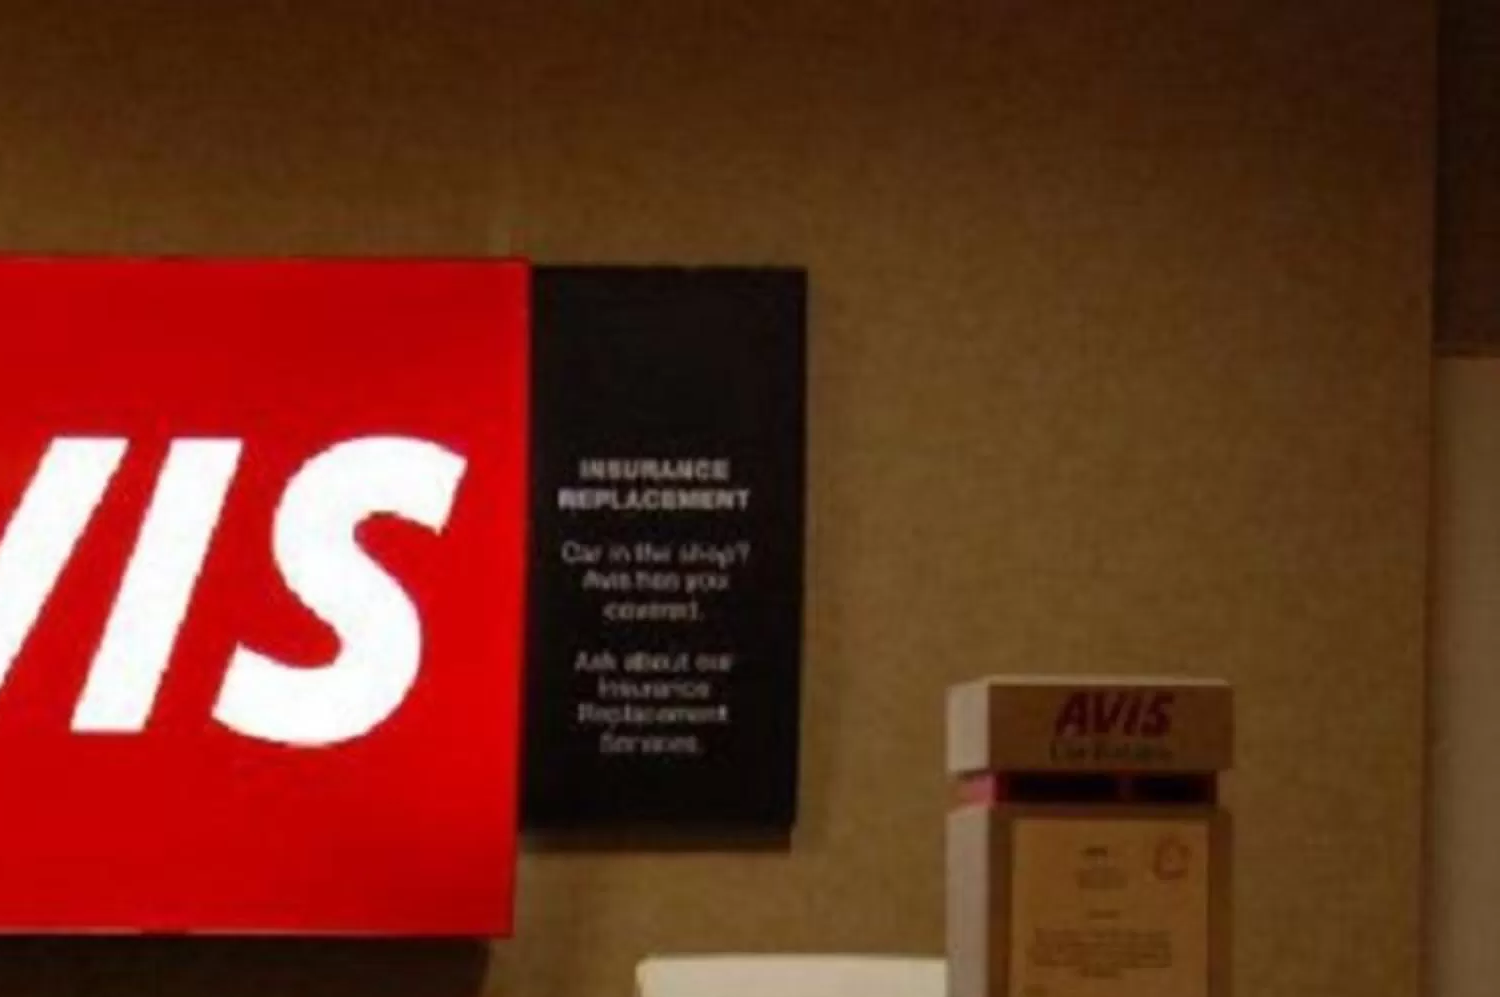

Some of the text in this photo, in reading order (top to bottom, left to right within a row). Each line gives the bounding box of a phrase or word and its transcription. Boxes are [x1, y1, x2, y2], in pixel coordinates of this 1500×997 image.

[579, 458, 730, 480] INSURANCE
[557, 488, 750, 510] REPLACEMENT
[561, 541, 750, 568] Car in the shop?
[581, 570, 631, 590] Avis
[635, 570, 680, 591] has
[574, 651, 734, 671] Ask about our
[597, 676, 710, 698] Insurance
[577, 702, 729, 727] Replacement
[1055, 692, 1174, 736] AVIS
